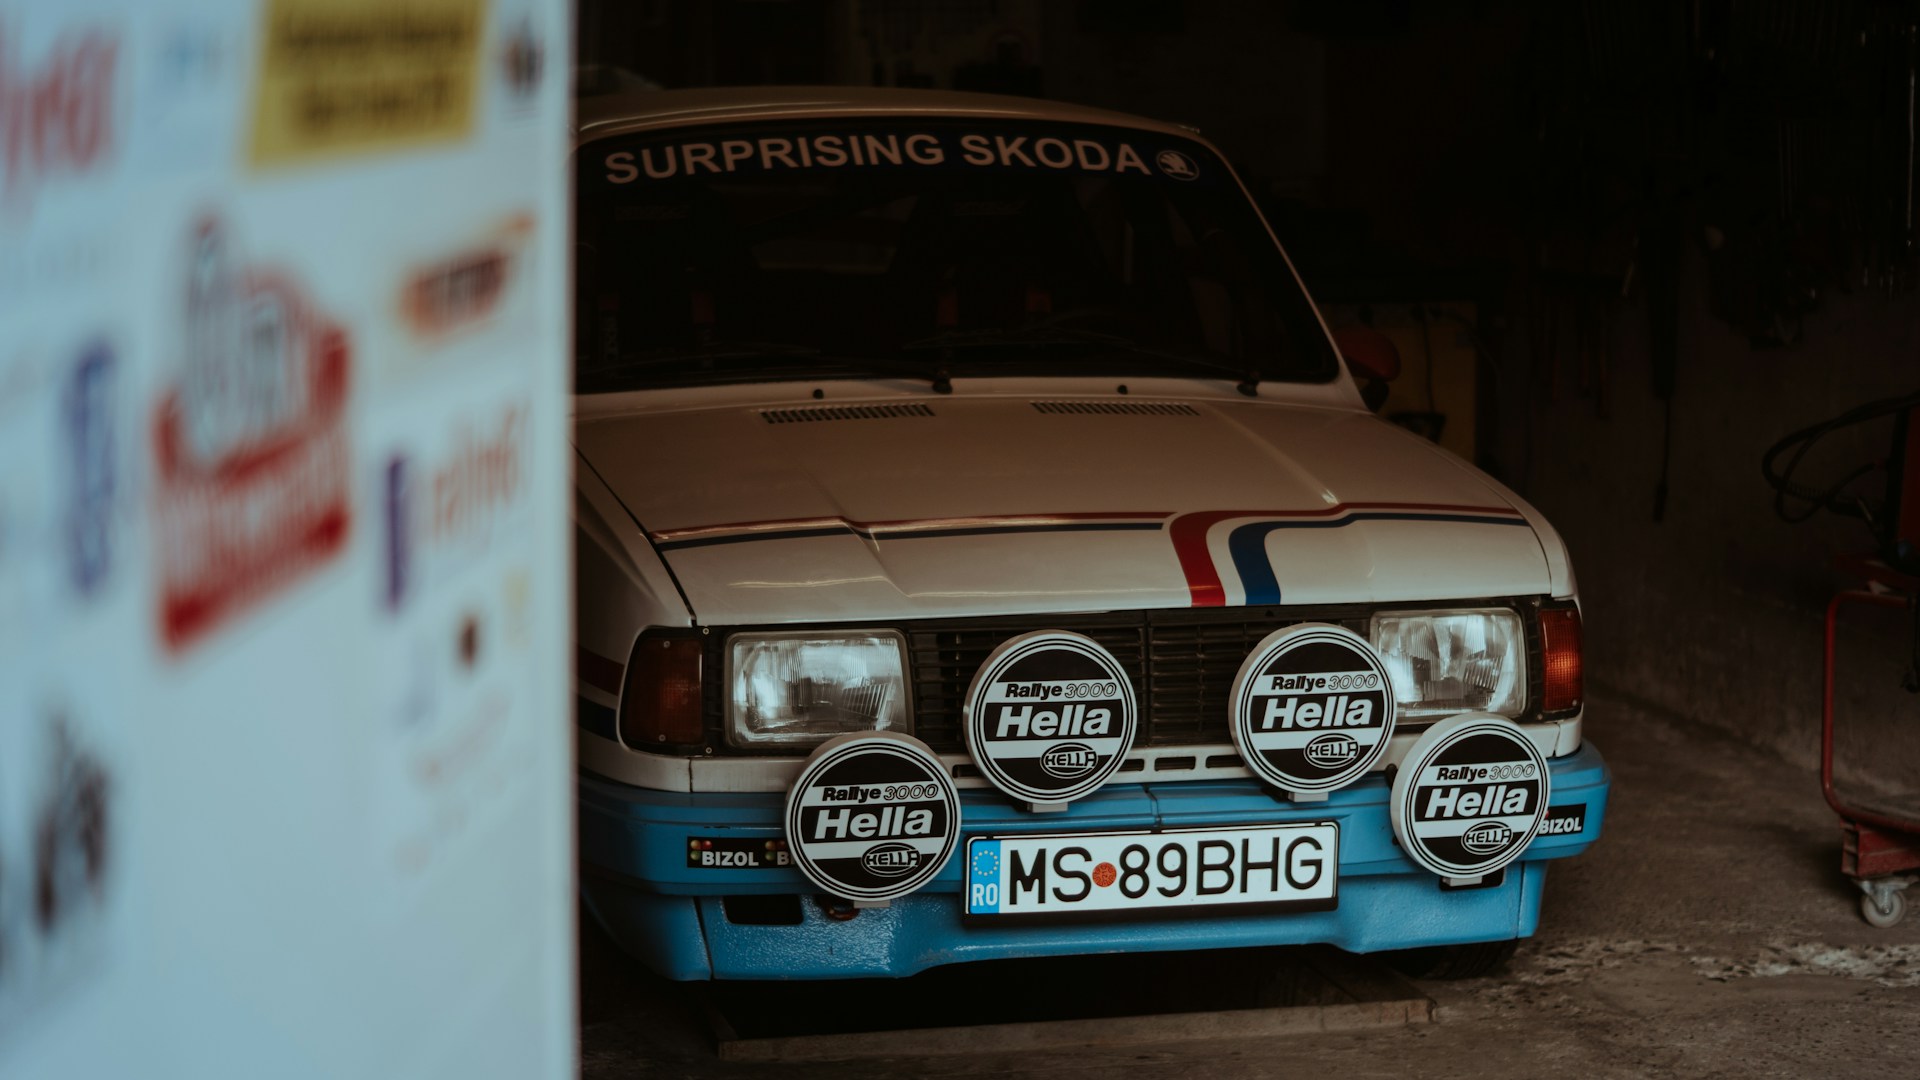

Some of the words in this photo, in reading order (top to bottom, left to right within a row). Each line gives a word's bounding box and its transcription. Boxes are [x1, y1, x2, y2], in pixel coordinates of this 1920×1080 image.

[605, 134, 945, 184] SURPRISING
[960, 135, 1152, 175] SKODA
[1005, 683, 1062, 700] Rallye
[1064, 682, 1117, 698] 3000
[1271, 675, 1326, 692] Rallye
[1328, 674, 1378, 690] 3000
[996, 704, 1112, 737] Hella
[1262, 695, 1373, 729] Hella
[1308, 741, 1359, 758] HELLA
[1045, 751, 1098, 768] HELLA
[1436, 766, 1488, 782] Rallye
[1489, 763, 1536, 780] 3000
[822, 785, 881, 803] Rallye
[883, 783, 938, 801] 3000
[1424, 784, 1529, 819] Hella
[814, 806, 933, 840] Hella
[1539, 817, 1582, 834] BIZOL
[1465, 829, 1512, 845] HELLA
[702, 851, 759, 866] BIZOL
[866, 849, 921, 868] HELLA
[1009, 846, 1093, 905] MS
[972, 883, 998, 906] RO
